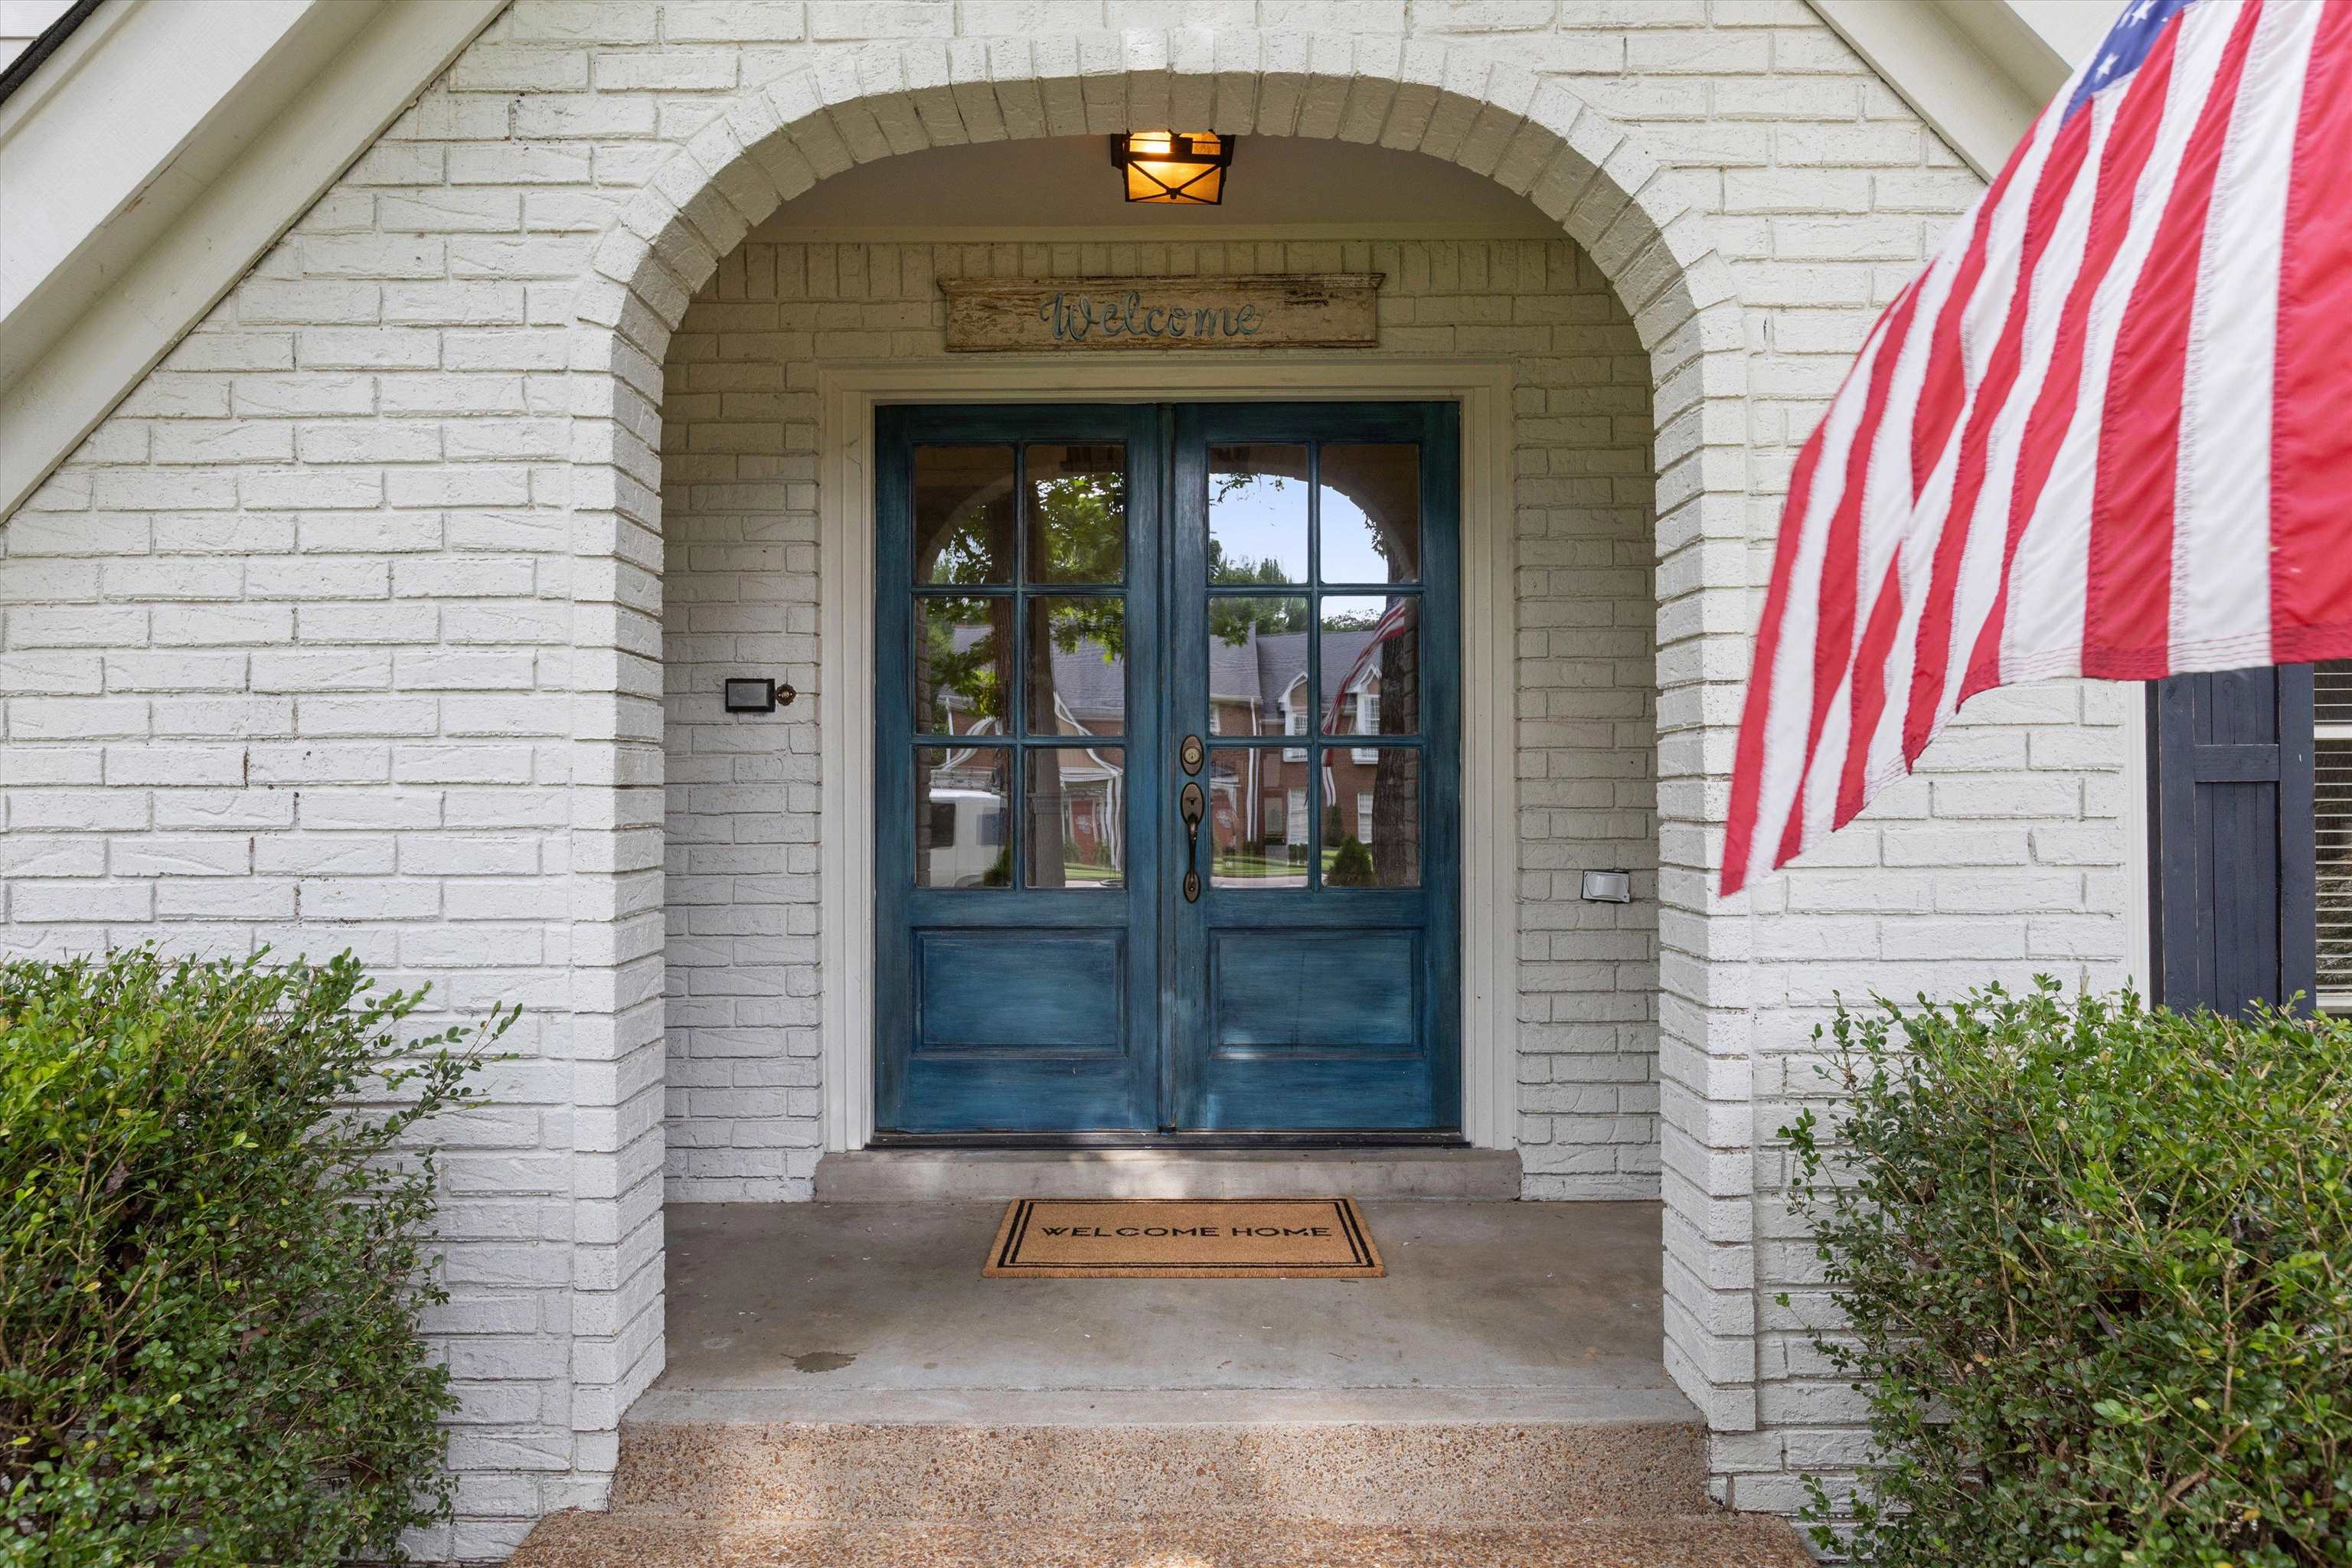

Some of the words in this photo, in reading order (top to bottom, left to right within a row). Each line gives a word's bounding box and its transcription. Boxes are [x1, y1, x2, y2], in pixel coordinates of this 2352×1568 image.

[1040, 291, 1263, 341] Welcome
[1042, 1227, 1220, 1237] WELCOME
[1231, 1227, 1333, 1237] HOME
